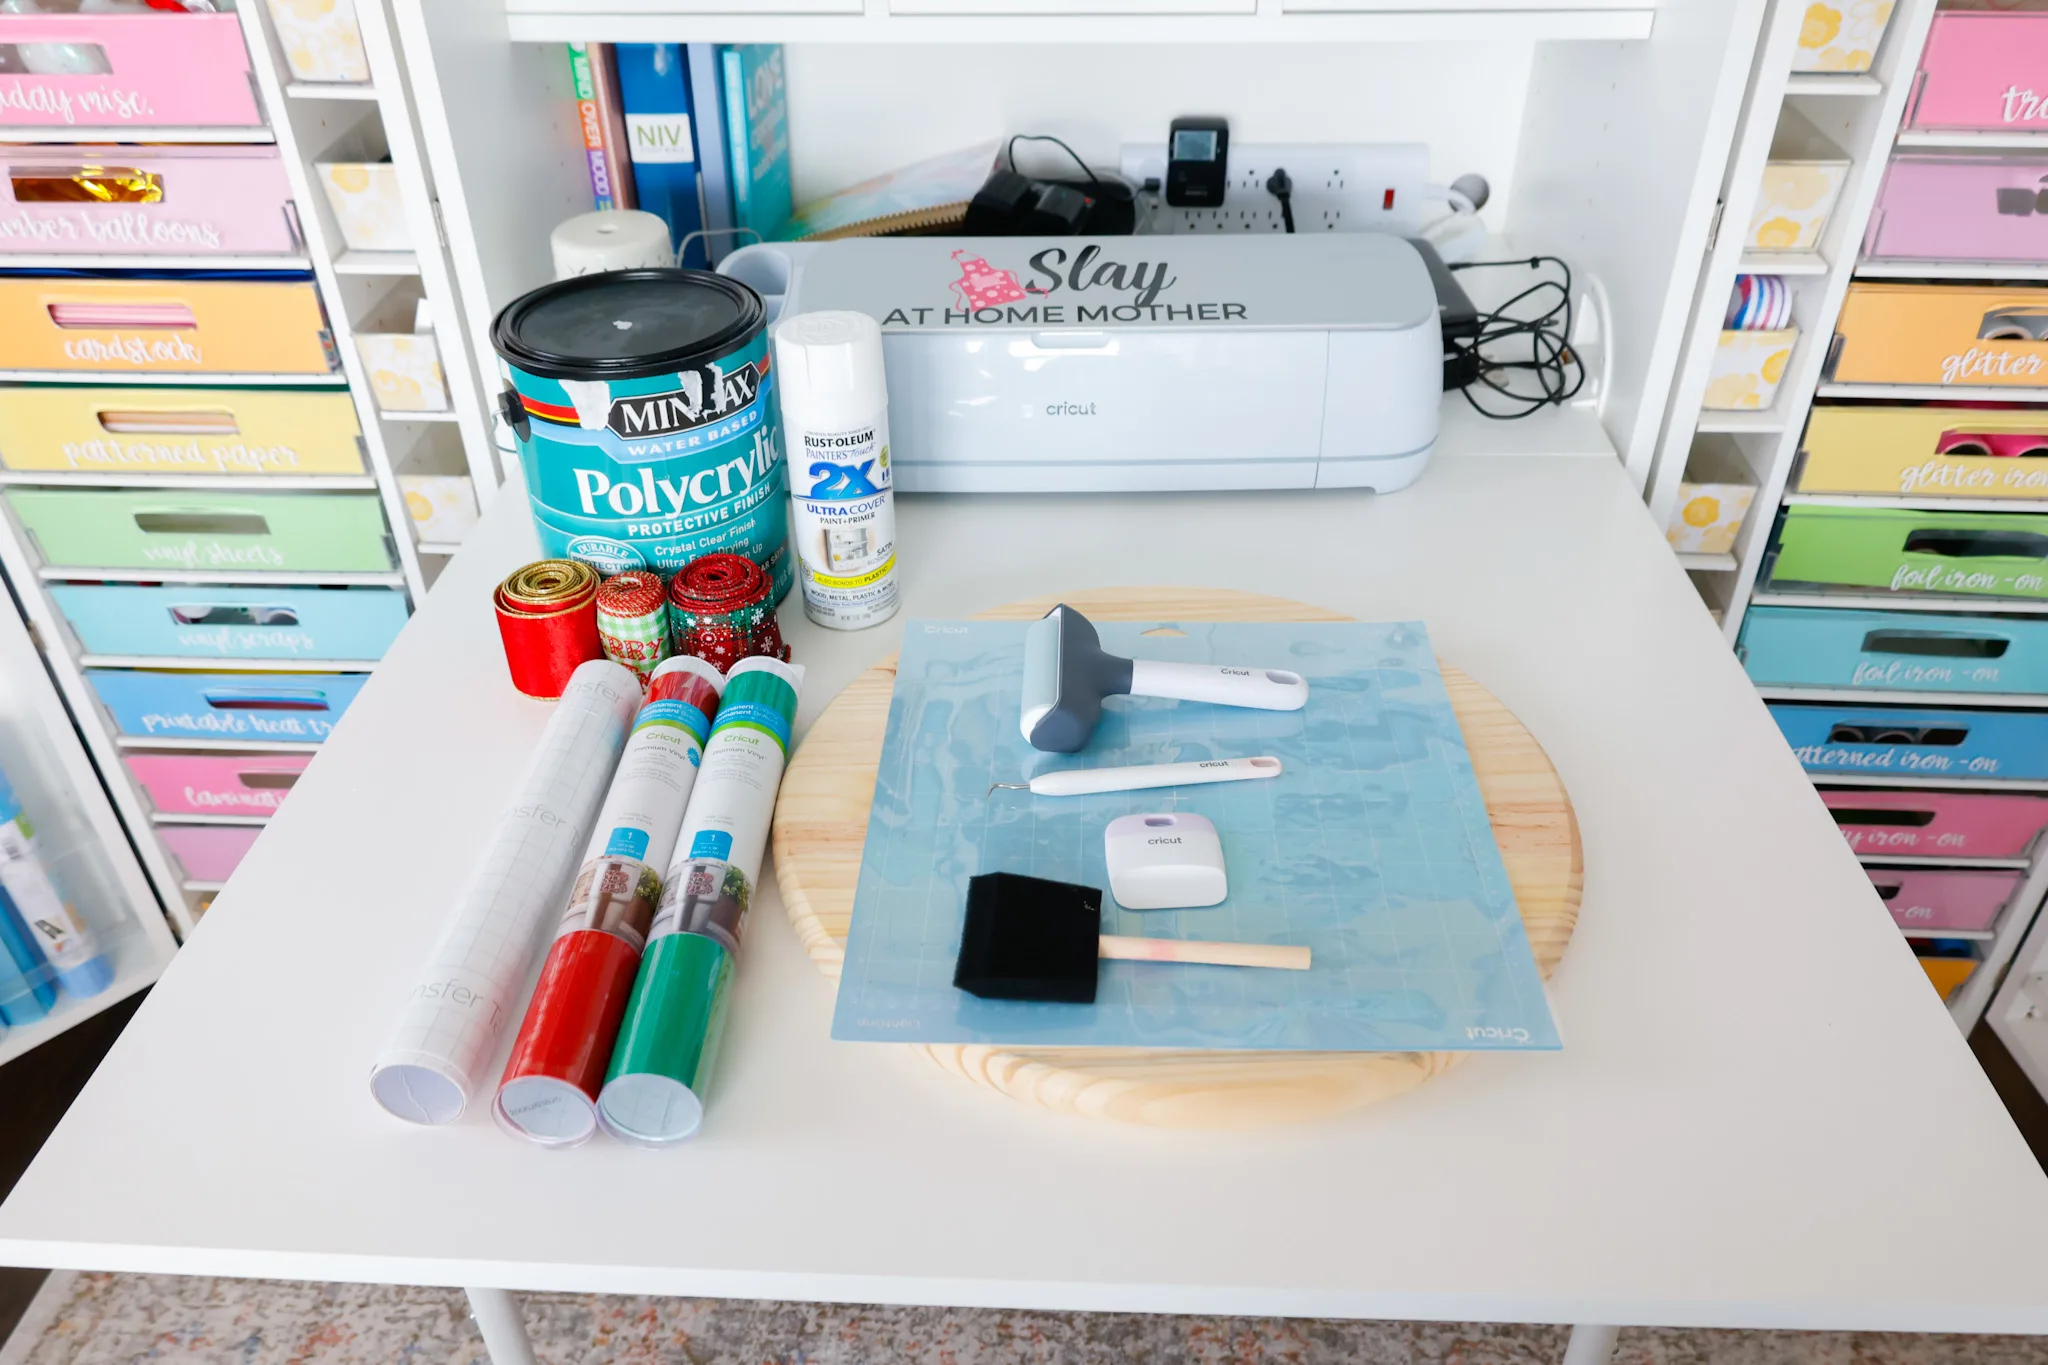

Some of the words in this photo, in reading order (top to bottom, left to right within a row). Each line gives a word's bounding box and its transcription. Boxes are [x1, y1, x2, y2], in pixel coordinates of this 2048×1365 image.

[77, 85, 154, 118] misc.
[580, 101, 603, 148] OVER
[636, 123, 681, 147] NIV
[589, 150, 611, 196] MOOD
[80, 211, 221, 249] balloons
[1025, 244, 1177, 308] Slay
[881, 307, 934, 326] AT
[944, 304, 1064, 325] HOME
[1077, 302, 1248, 323] MOTHER
[64, 334, 203, 364] cardstock
[1941, 347, 2045, 384] glitter
[621, 370, 754, 433] MINAX
[1046, 401, 1097, 416] cricut
[628, 435, 701, 457] WATER
[707, 410, 757, 442] BASED
[62, 439, 206, 469] patterned
[211, 442, 299, 473] paper
[573, 424, 780, 519] Polycrylic
[809, 458, 879, 501] 2X
[1900, 459, 1998, 493] glitter
[627, 505, 730, 537] PROTECTIVE
[734, 484, 771, 514] FINISH
[806, 503, 848, 516] ULTRA
[849, 495, 886, 515] COVER
[576, 542, 629, 558] DURABLE
[654, 540, 697, 557] Crystal
[699, 531, 727, 548] Clear
[729, 518, 757, 539] Finish
[876, 541, 893, 556] SATIN
[142, 539, 200, 569] vinyl
[204, 542, 285, 566] sheets
[656, 557, 686, 570] Ultra
[864, 565, 889, 582] PLASTIC
[1890, 563, 1944, 591] foil
[1944, 568, 1998, 589] iron
[853, 591, 876, 601] PLASTIC
[177, 627, 235, 654] vinyl
[236, 630, 315, 654] scraps
[923, 624, 969, 635] Cricut
[1220, 667, 1250, 677] Cricut
[1852, 660, 1904, 686] foil
[1904, 664, 1955, 682] iron
[141, 711, 248, 734] printable
[248, 713, 307, 735] heat
[646, 732, 681, 745] Cricut
[723, 734, 760, 745] Cricut
[1199, 760, 1229, 768] cricut
[1900, 749, 1953, 770] iron
[1147, 836, 1183, 845] cricut
[1867, 828, 1920, 846] iron
[1464, 1026, 1534, 1045] Cricut
